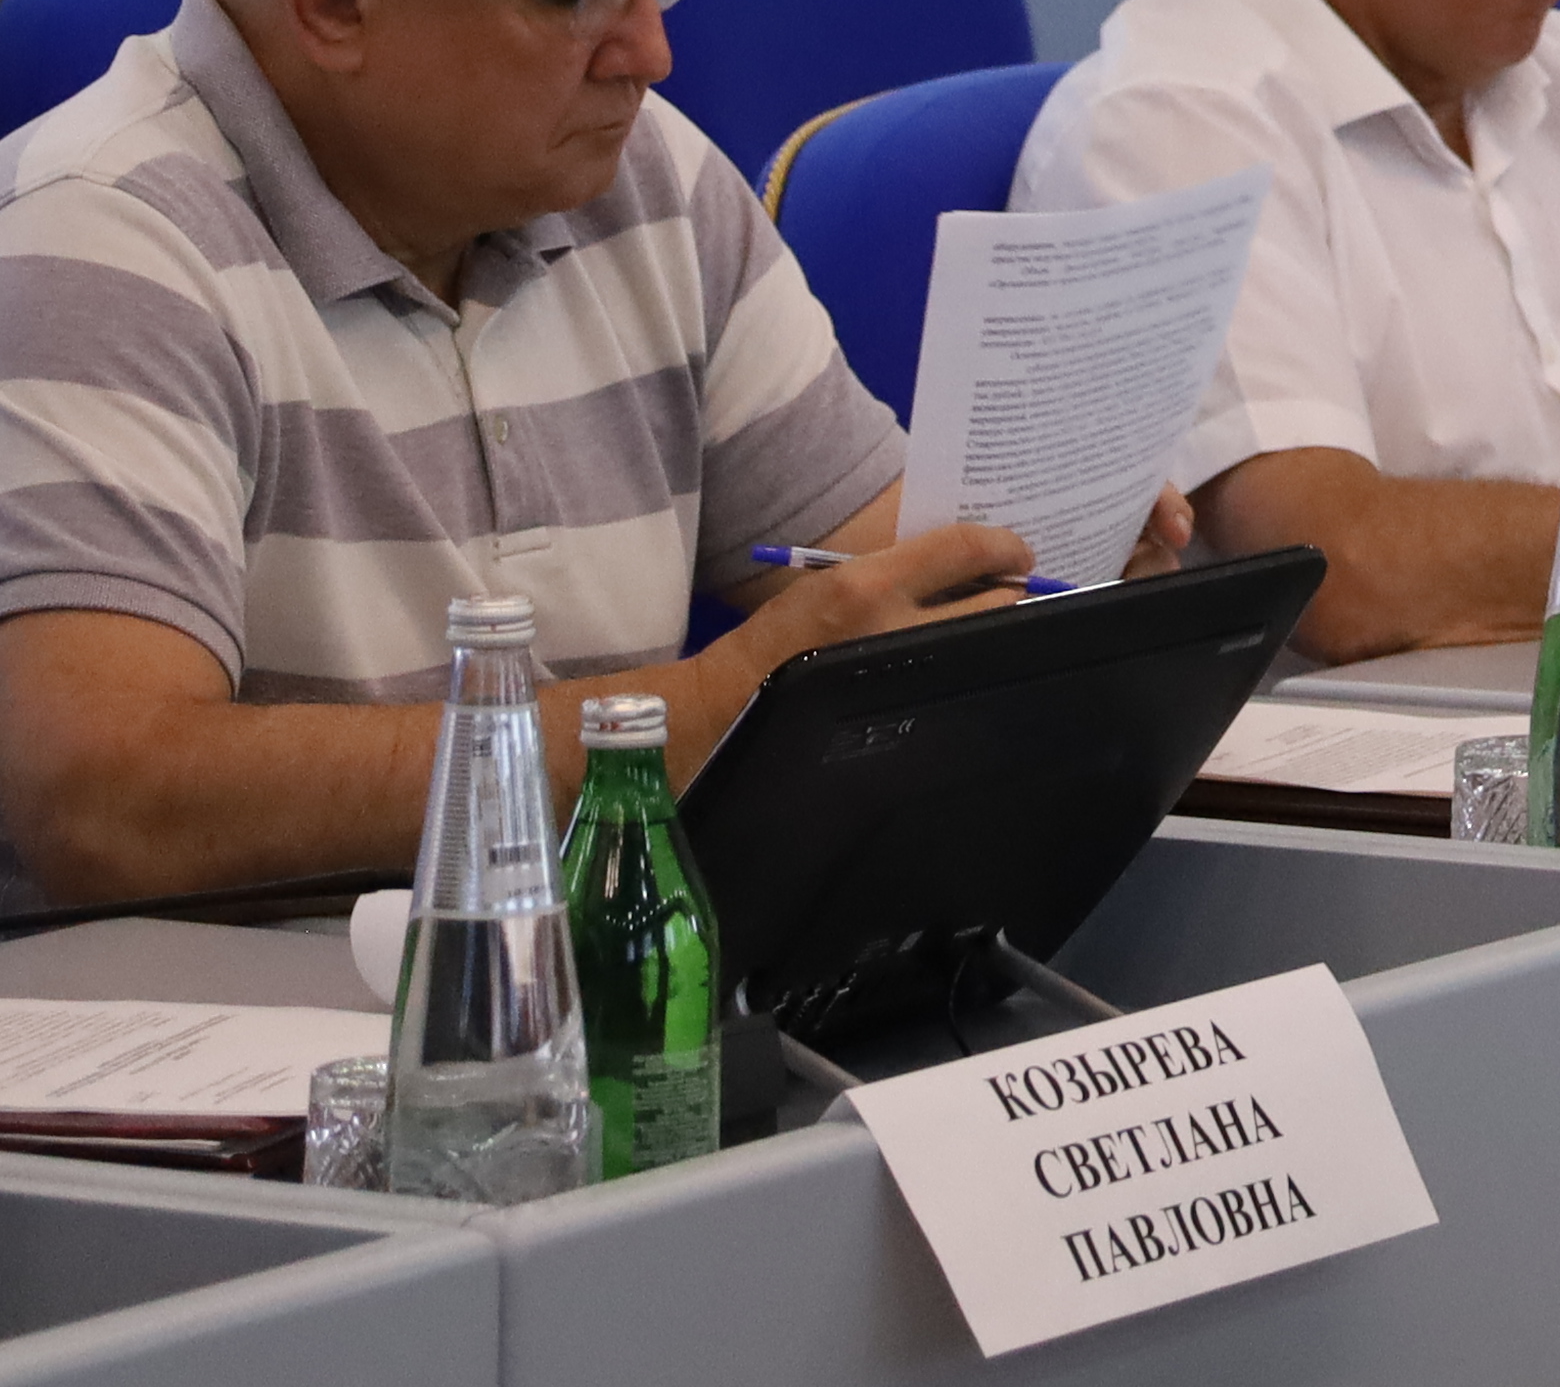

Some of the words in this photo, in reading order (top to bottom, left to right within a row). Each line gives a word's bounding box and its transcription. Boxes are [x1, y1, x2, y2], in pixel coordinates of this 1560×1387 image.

[987, 1019, 1247, 1121] КОЗЫРЕВА
[1033, 1095, 1284, 1199] СВЕТЛАНА
[1063, 1173, 1317, 1283] ПАВЛОВНА
